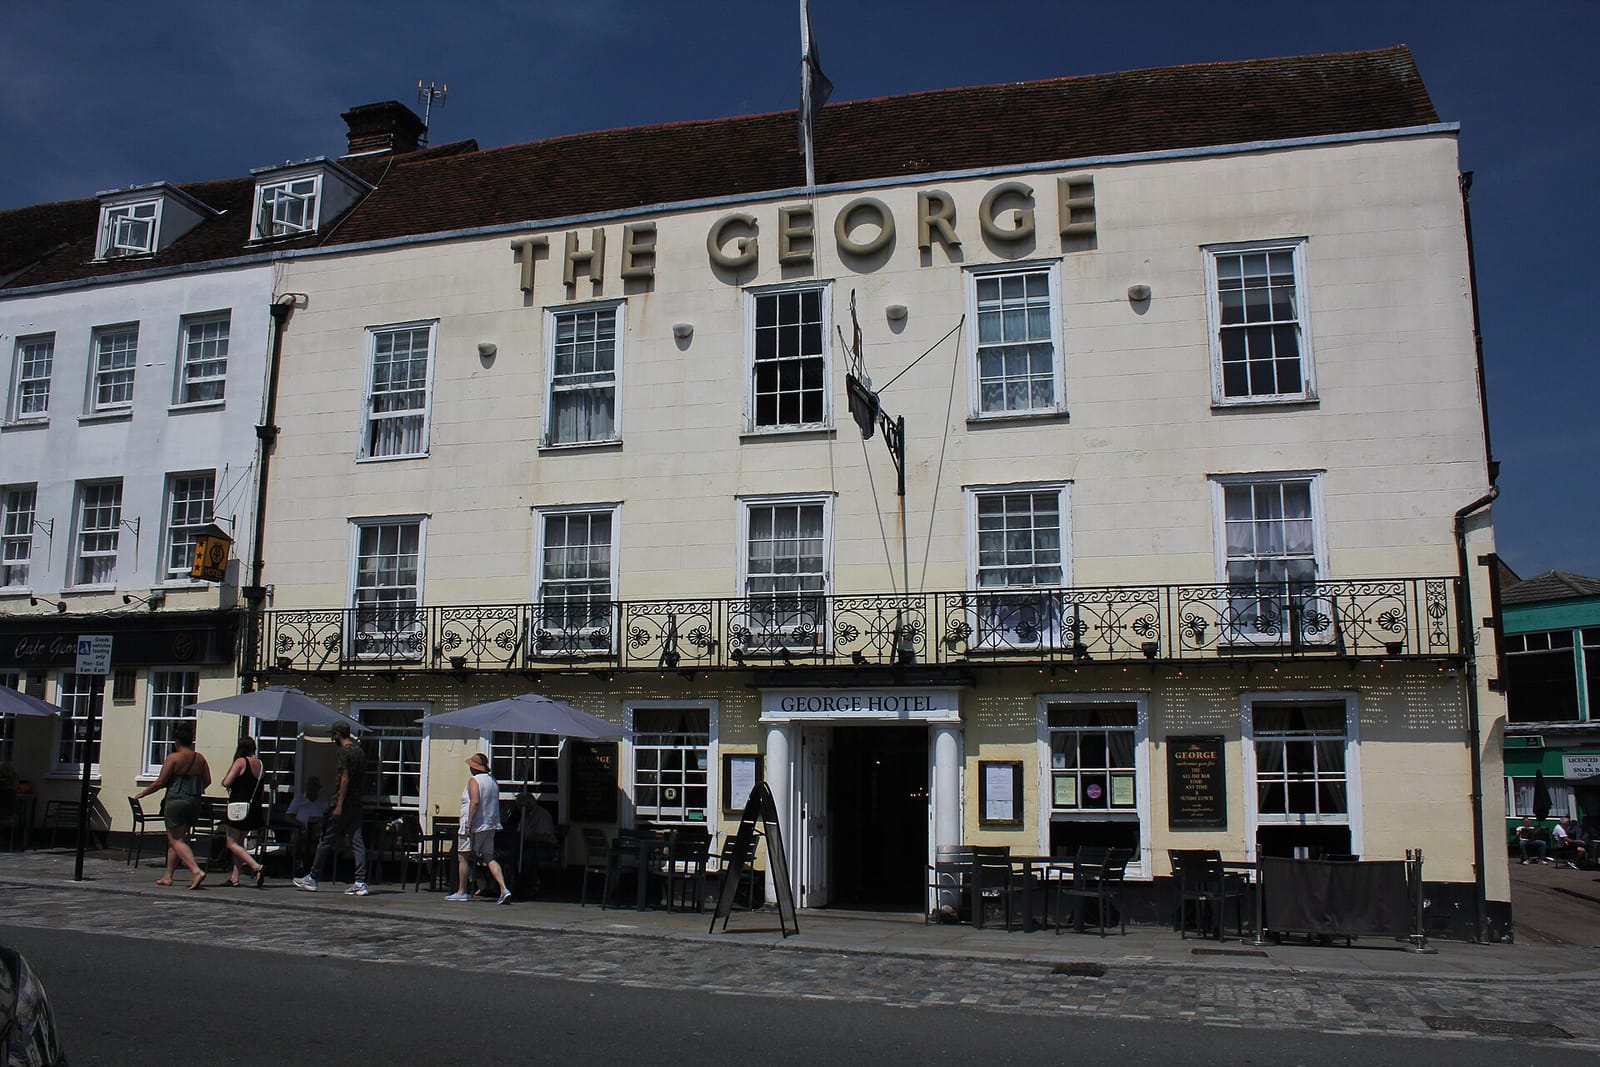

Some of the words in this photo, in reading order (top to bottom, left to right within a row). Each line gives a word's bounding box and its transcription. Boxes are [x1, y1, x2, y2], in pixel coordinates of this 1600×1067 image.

[510, 221, 657, 292] THE
[706, 173, 1097, 268] GEORGE
[781, 696, 864, 712] GEORGE
[868, 695, 937, 712] HOTEL
